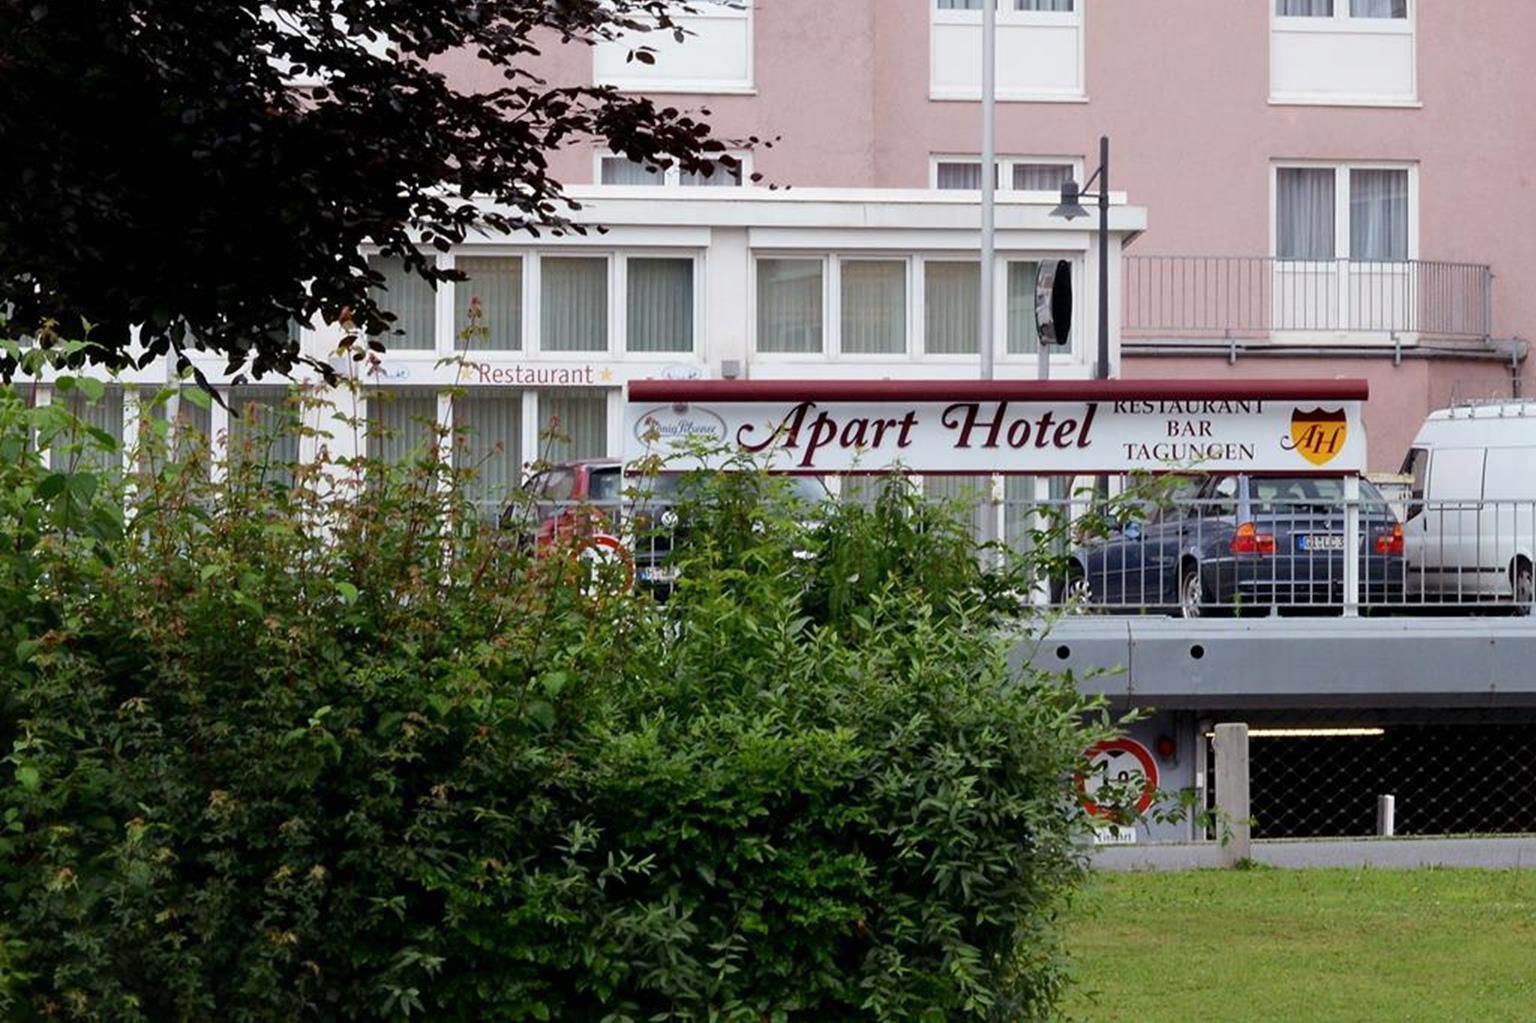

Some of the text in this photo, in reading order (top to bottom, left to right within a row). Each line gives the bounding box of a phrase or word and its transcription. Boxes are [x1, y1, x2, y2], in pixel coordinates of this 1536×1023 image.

[479, 362, 594, 384] Restaurant
[1112, 400, 1264, 414] RESTAURANT
[736, 401, 1098, 468] Apart Hotel
[1166, 420, 1213, 438] BAR
[1280, 423, 1346, 455] AH
[1122, 443, 1256, 461] TAGUNGEN
